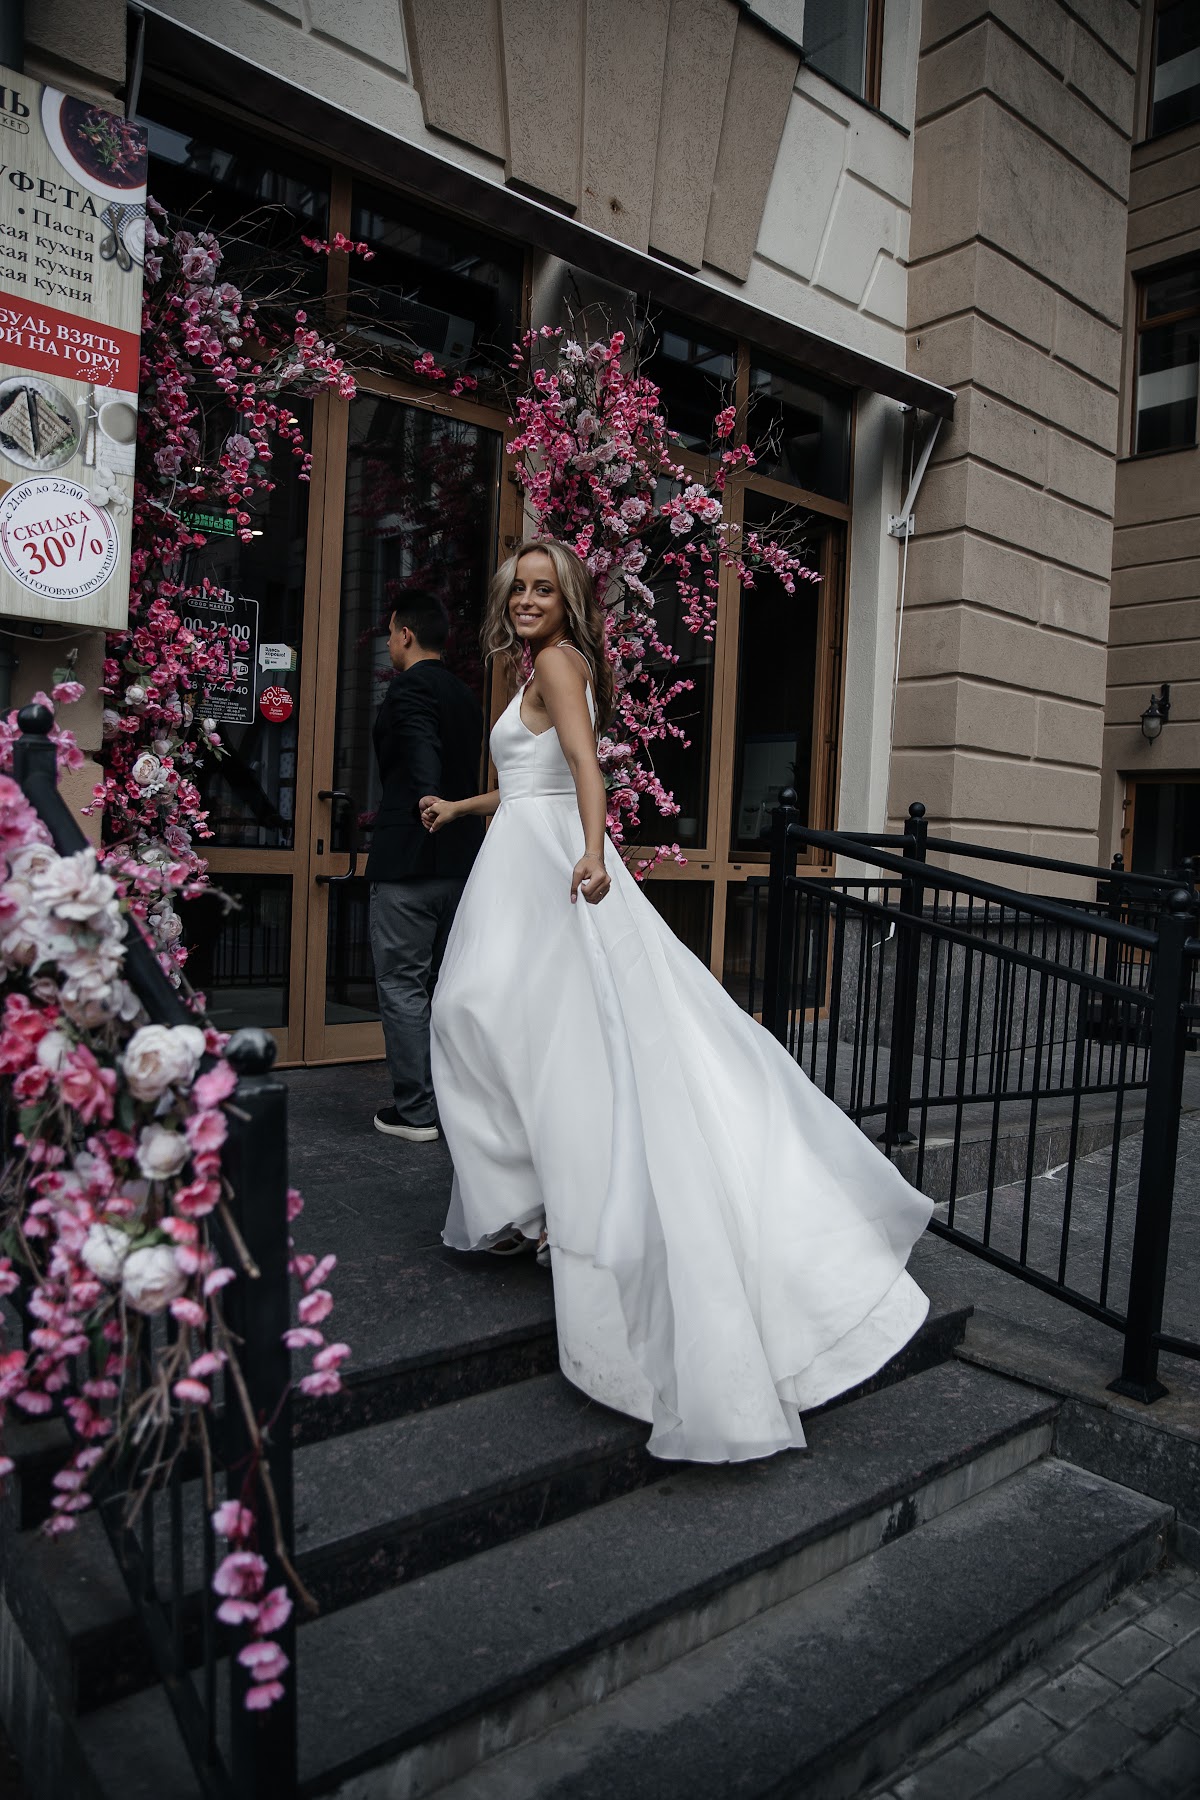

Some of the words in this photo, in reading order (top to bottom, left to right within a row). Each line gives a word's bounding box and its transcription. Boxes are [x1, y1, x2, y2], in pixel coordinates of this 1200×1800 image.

[33, 207, 95, 243] Паста
[35, 235, 94, 263] кухня
[35, 255, 93, 284] кухня
[33, 276, 93, 304] кухня
[28, 334, 60, 357] НА
[63, 344, 120, 373] ГОРУ!
[56, 324, 121, 355] ВЗЯТЬ
[7, 488, 32, 511] 21:00
[53, 482, 83, 500] 22:00
[13, 510, 91, 541] СКИДКА
[22, 525, 103, 575] 30%
[16, 567, 28, 582] НА
[29, 579, 79, 596] ГОТОВУЮ
[79, 539, 114, 592] ПРОДУКЦИЮ
